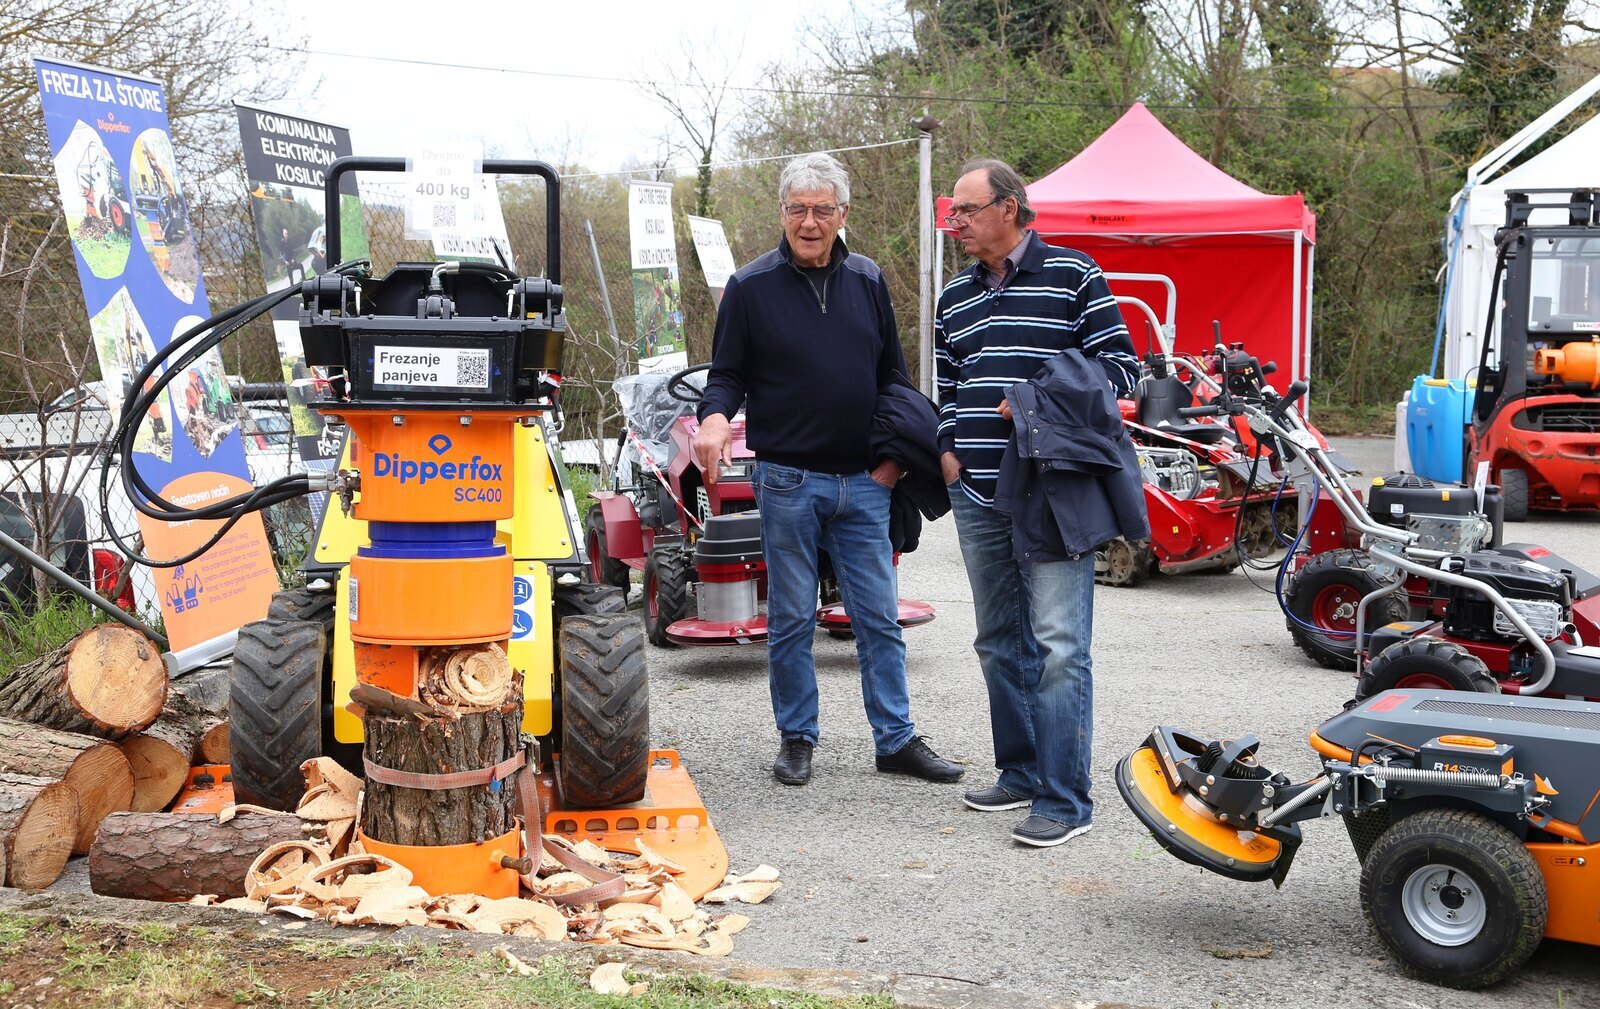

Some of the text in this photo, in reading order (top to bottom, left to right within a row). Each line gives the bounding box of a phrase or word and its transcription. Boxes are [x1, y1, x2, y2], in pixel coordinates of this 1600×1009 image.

[41, 68, 163, 112] FREZA ZA ŠTORE
[255, 112, 337, 146] KOMUNALNA
[415, 182, 470, 199] 400 kg
[380, 351, 441, 368] Frezanje
[382, 370, 438, 384] panjeva
[373, 453, 502, 485] Dipperfox
[454, 487, 502, 502] SC400
